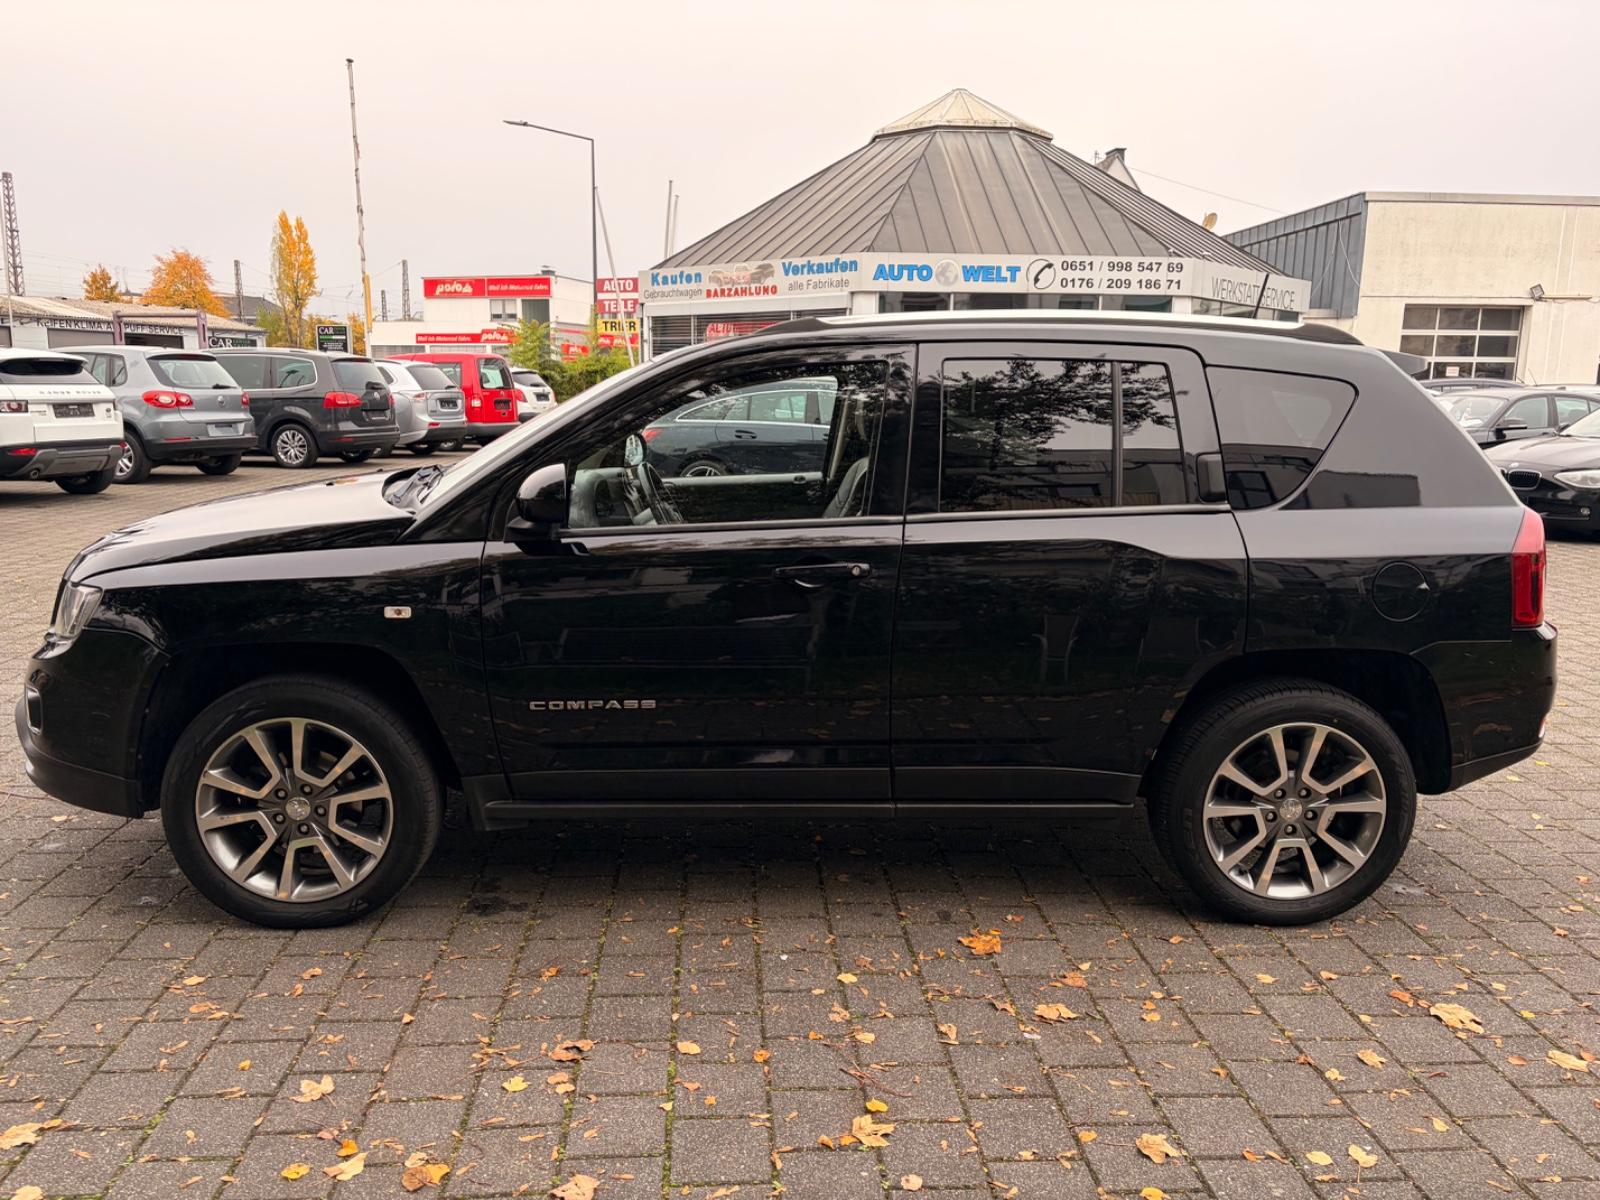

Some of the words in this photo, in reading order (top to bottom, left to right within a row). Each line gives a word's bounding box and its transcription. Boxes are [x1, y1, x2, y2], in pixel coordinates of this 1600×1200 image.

[781, 256, 858, 276] Verkaufen
[1061, 260, 1094, 271] 0651
[1107, 261, 1133, 272] 998
[1137, 262, 1162, 272] 547
[1167, 262, 1183, 273] 69
[651, 271, 702, 286] Kaufen
[873, 264, 933, 281] AUTO
[962, 265, 1021, 282] WELT
[788, 280, 804, 291] alle
[806, 278, 849, 290] Fabrikate
[1060, 278, 1094, 288] 0176
[1106, 279, 1131, 289] 209
[1137, 279, 1161, 289] 186
[1166, 279, 1181, 289] 71
[643, 288, 702, 299] Gebrauchtwagen
[706, 284, 778, 298] BARZAHLUNG
[149, 324, 184, 335] SERVICE
[319, 326, 335, 334] CAR
[209, 337, 233, 348] CAR
[529, 700, 657, 711] COMPASS
